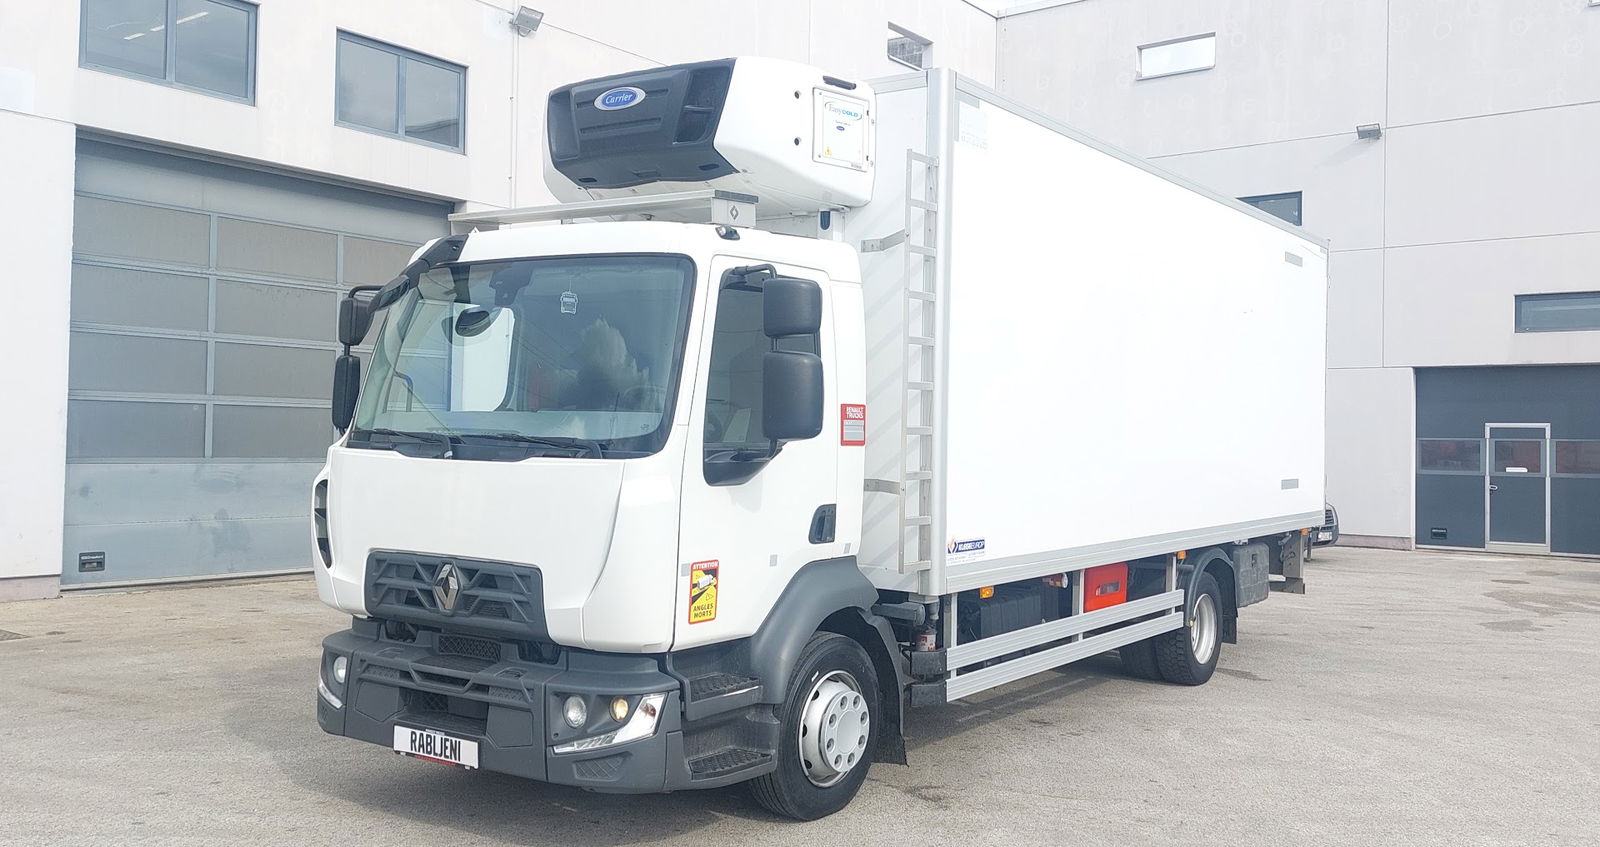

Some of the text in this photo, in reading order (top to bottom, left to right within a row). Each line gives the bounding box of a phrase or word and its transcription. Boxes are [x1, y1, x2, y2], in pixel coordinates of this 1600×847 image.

[605, 94, 632, 104] Carrier
[846, 411, 864, 419] TRUCKS
[693, 561, 719, 570] ATTENTION
[693, 603, 714, 612] ANGLES
[693, 610, 712, 619] MORTS
[410, 730, 461, 762] RABLJENI
